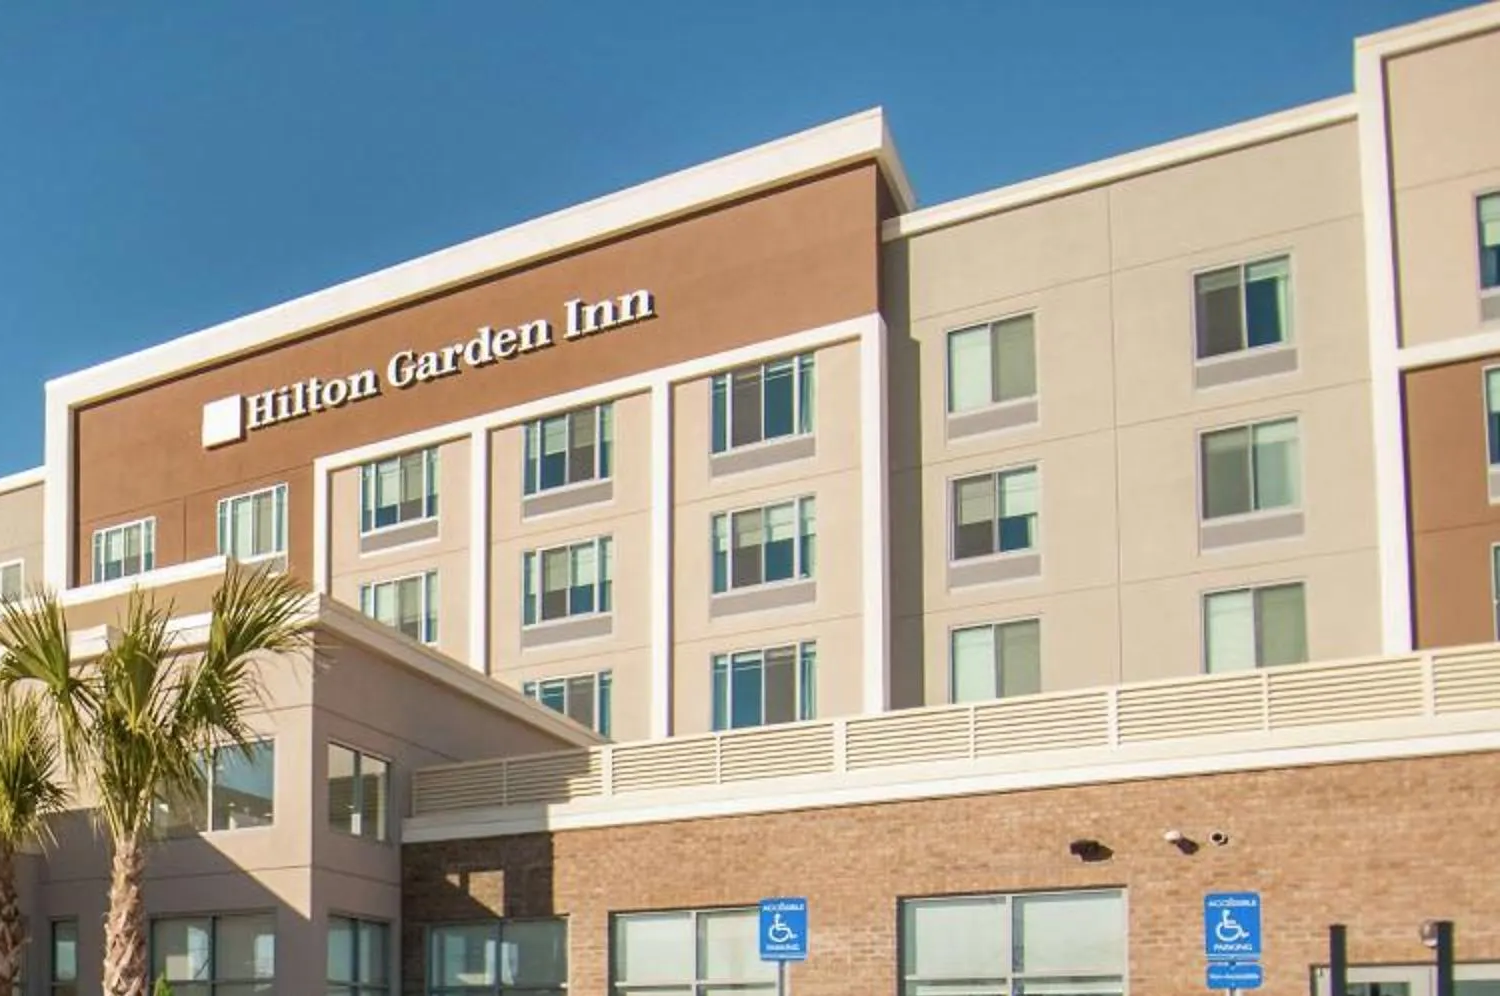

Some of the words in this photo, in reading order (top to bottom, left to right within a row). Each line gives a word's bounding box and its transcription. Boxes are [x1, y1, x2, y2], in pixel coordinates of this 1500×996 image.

[246, 368, 378, 430] Hilton
[387, 317, 553, 388] Garden
[563, 289, 653, 340] Inn
